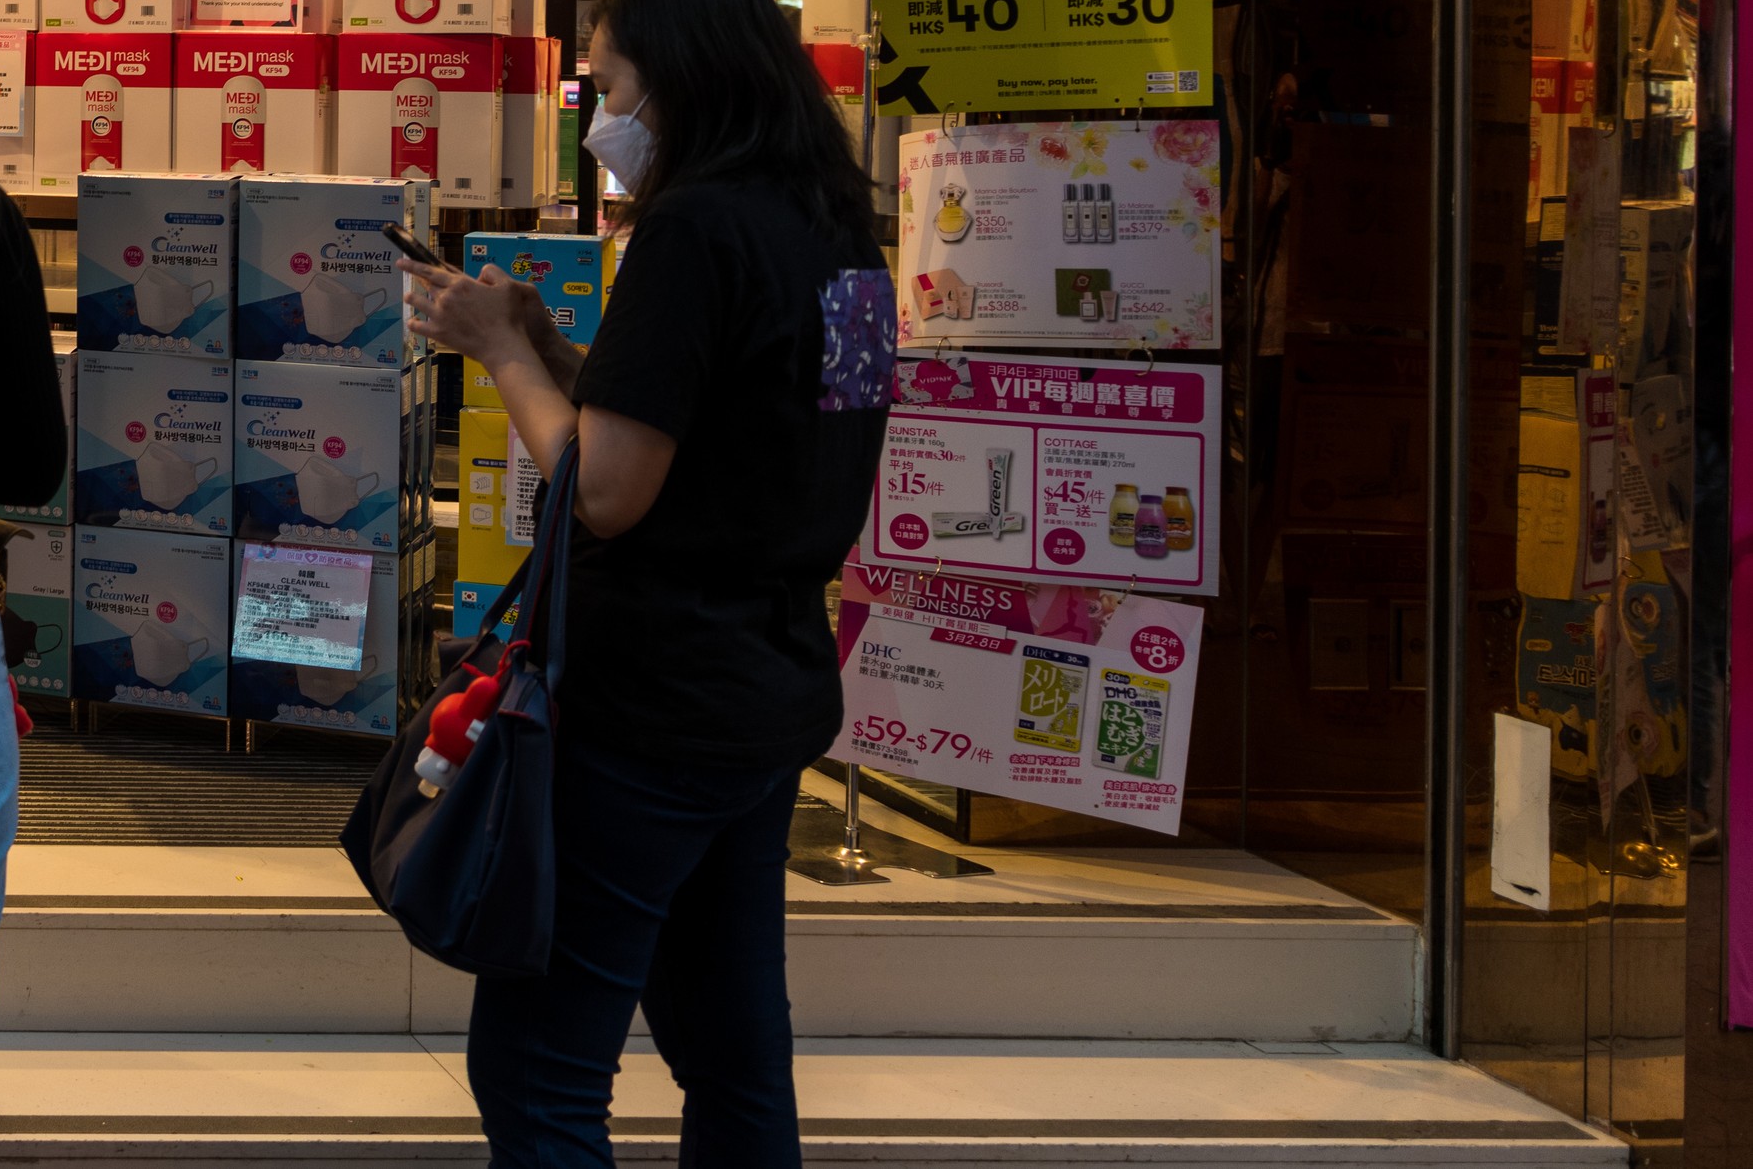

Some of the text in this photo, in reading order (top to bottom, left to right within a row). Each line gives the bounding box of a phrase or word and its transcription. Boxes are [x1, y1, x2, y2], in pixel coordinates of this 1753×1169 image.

[908, 0, 943, 17] 即減
[1069, 12, 1104, 28] HK$
[909, 20, 944, 35] HK$
[114, 49, 150, 62] mask
[256, 49, 294, 63] mask
[429, 51, 470, 65] mask
[122, 65, 139, 73] KF94
[439, 68, 457, 76] KF94
[998, 79, 1018, 89] Buy
[1048, 79, 1068, 88] pay
[87, 101, 115, 112] mask
[228, 103, 258, 114] mask
[398, 106, 431, 118] mask
[151, 236, 218, 255] CleanWell
[320, 242, 392, 261] CleanWell
[151, 255, 218, 267] 황사방역용마스크
[320, 261, 392, 274] 황사방역용마스크
[988, 365, 1079, 380] 3月4日-3月10日
[990, 377, 1176, 409] VIP每週驚喜價
[154, 413, 222, 432] CleanWell
[246, 419, 315, 439] CleanWell
[154, 431, 222, 444] 황사방역용마스크
[888, 426, 937, 437] SUNSTAR
[246, 438, 315, 452] 황사방역용마스크
[928, 439, 945, 447] 160g
[1044, 437, 1098, 449] COTTAGE
[889, 459, 914, 472] 平均
[990, 470, 1002, 517] Green
[1044, 503, 1108, 519] 買一送一
[32, 585, 65, 595] Gray Large
[280, 577, 331, 589] CLEAN WELL
[864, 566, 1013, 610] WELLNESS
[85, 583, 150, 604] CleanWell
[85, 600, 150, 617] 황사방역용마스크
[890, 591, 992, 620] WEDNESDAY
[944, 631, 1001, 650] 3月2-8日
[1138, 632, 1179, 648] 任選2件
[862, 641, 902, 660] DHC
[1025, 646, 1052, 659] DHC
